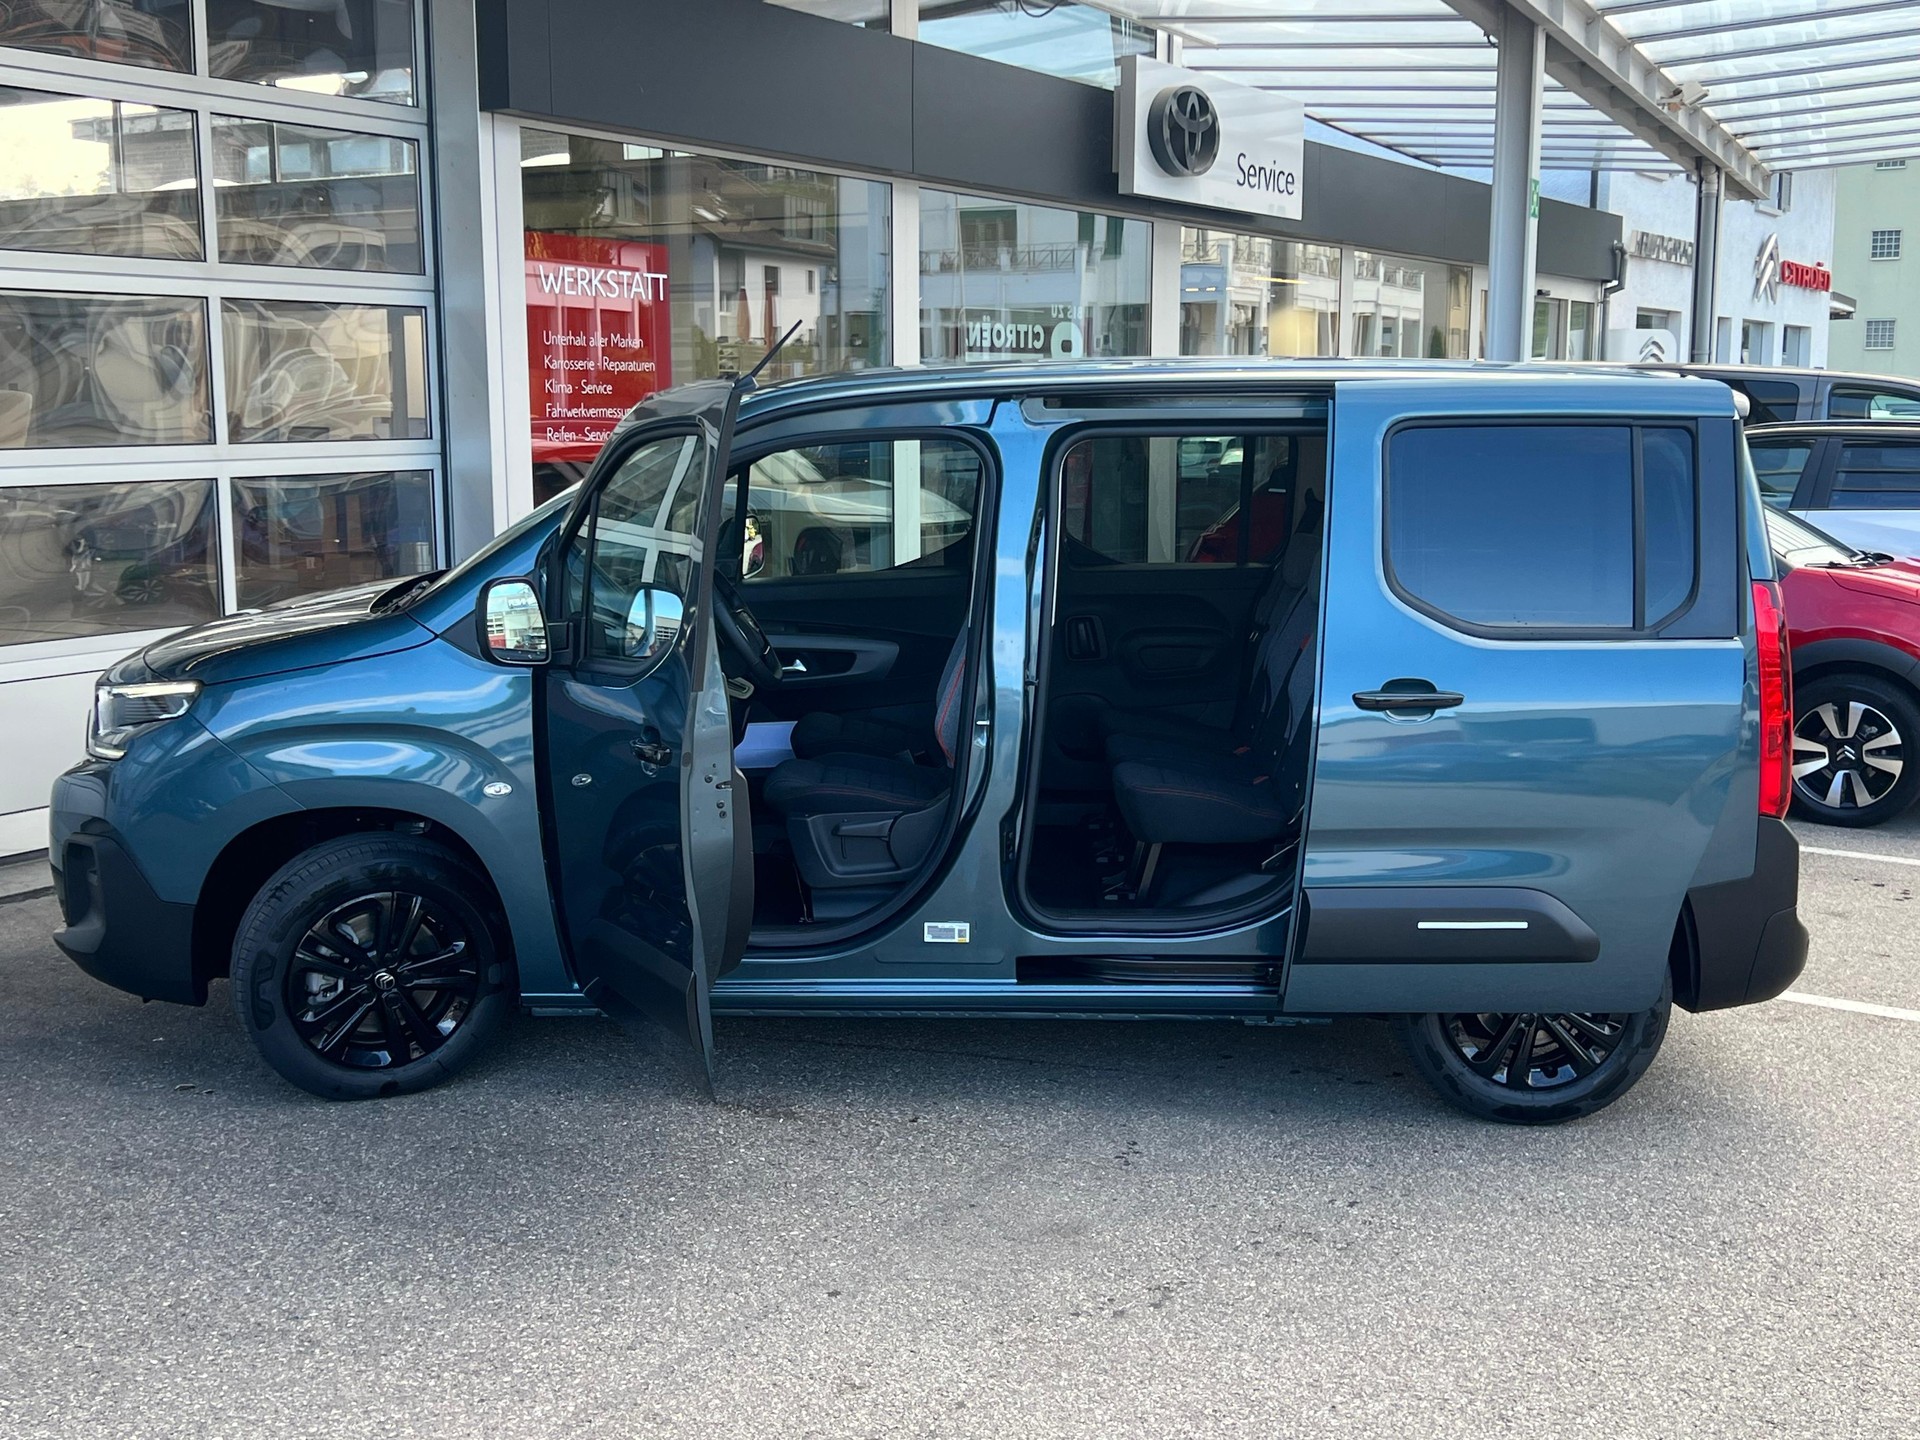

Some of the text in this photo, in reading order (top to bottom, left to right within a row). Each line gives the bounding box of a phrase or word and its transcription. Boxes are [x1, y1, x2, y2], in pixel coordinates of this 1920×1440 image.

[1237, 153, 1295, 196] Service
[539, 264, 668, 302] WERKSTATT
[543, 330, 644, 349] Unterhalt aller Marken
[544, 355, 595, 371] Karrosserie
[603, 356, 656, 375] Reparaturen
[545, 379, 573, 394] Klima
[581, 379, 613, 395] Service
[546, 426, 576, 442] Reifen
